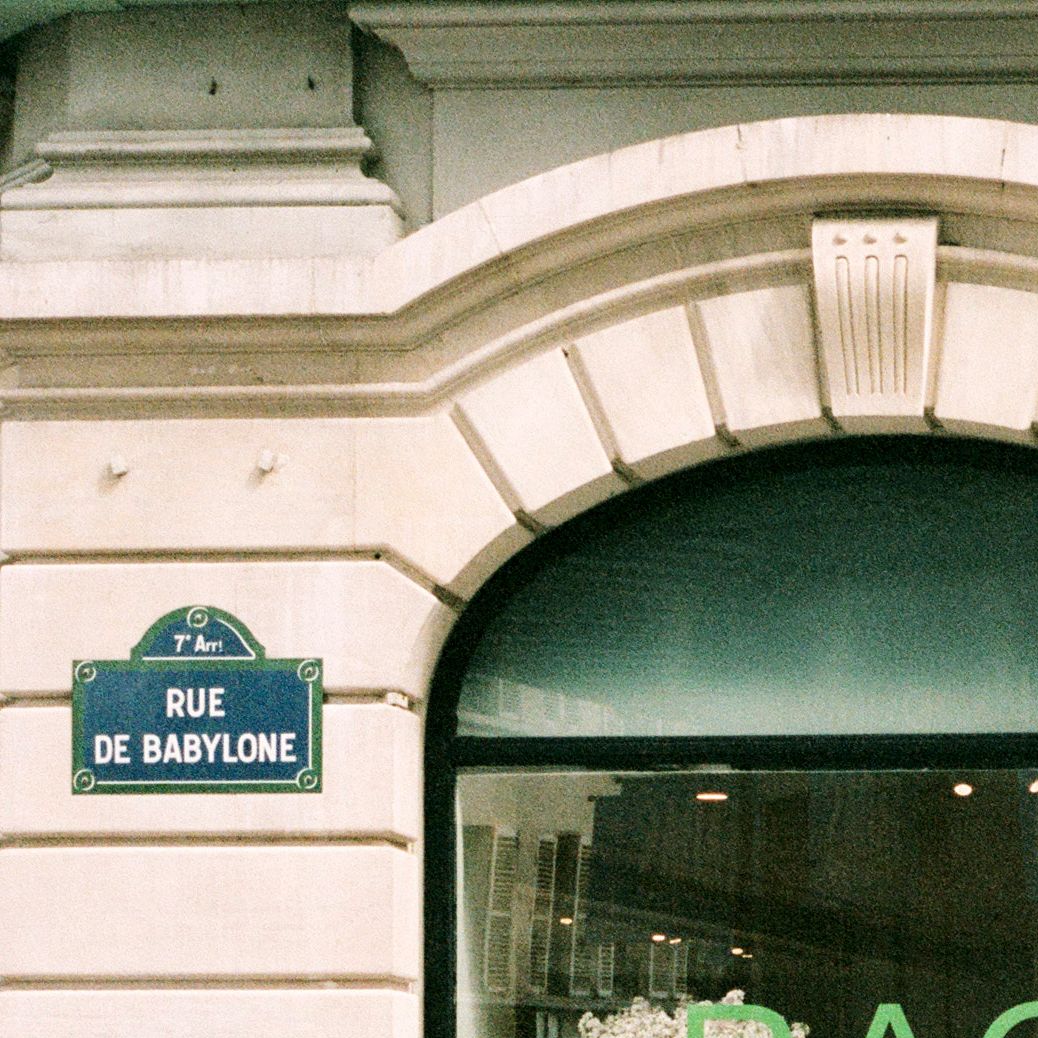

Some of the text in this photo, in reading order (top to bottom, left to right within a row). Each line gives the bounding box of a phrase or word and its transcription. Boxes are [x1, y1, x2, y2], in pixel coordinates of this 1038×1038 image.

[166, 688, 226, 718] RUE
[94, 732, 297, 765] DE BABYLONE
